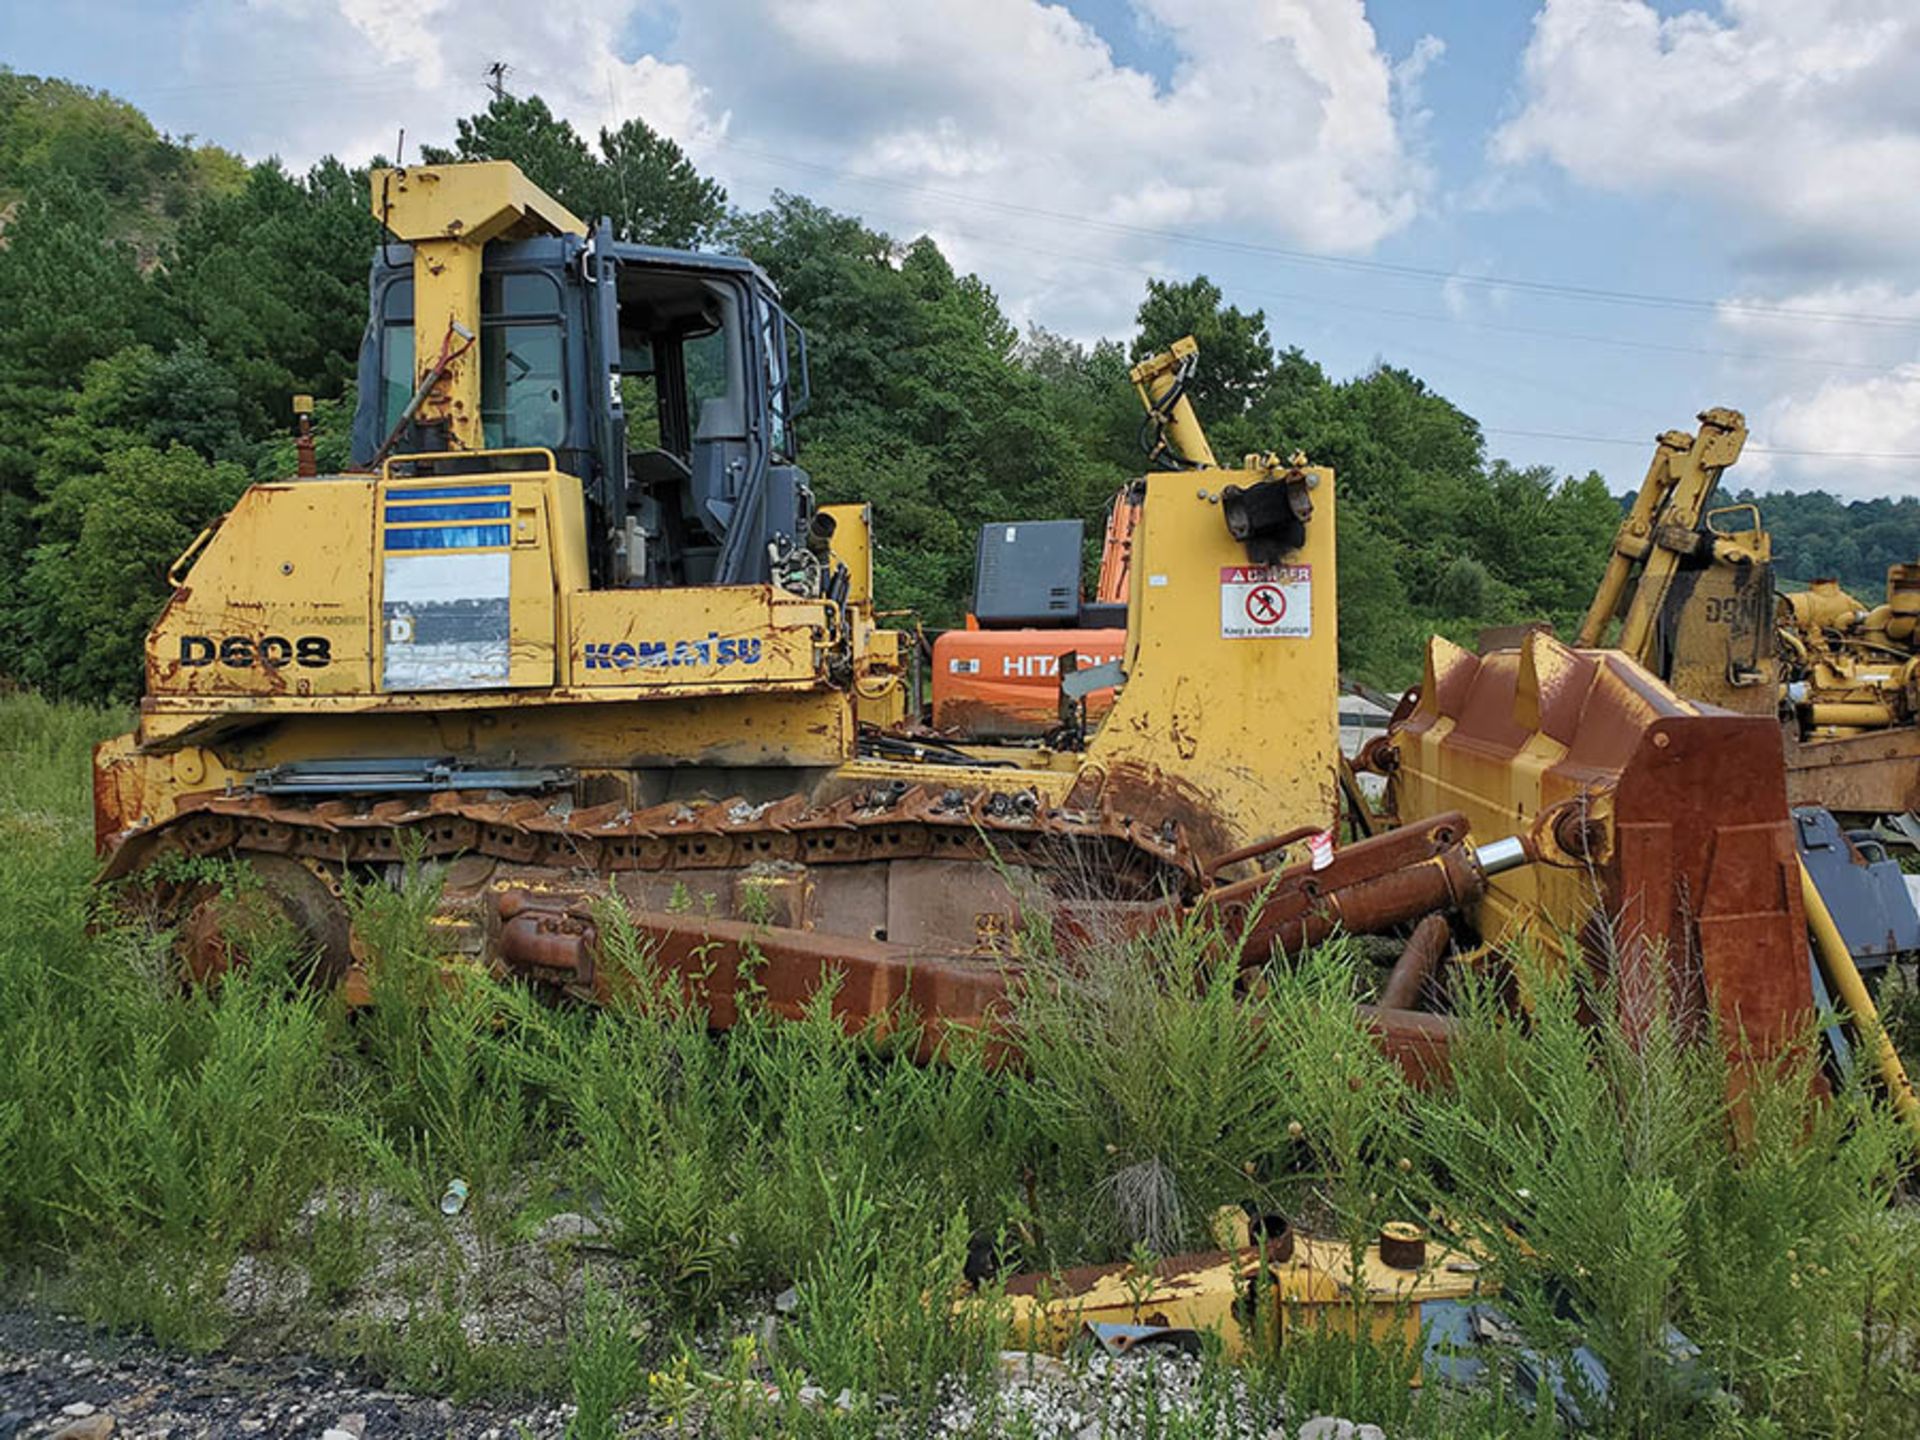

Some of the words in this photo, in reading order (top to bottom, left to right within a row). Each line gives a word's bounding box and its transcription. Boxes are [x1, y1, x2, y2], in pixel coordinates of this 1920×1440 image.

[390, 618, 412, 641] D
[180, 635, 331, 668] D608
[584, 632, 762, 669] KOMATSU
